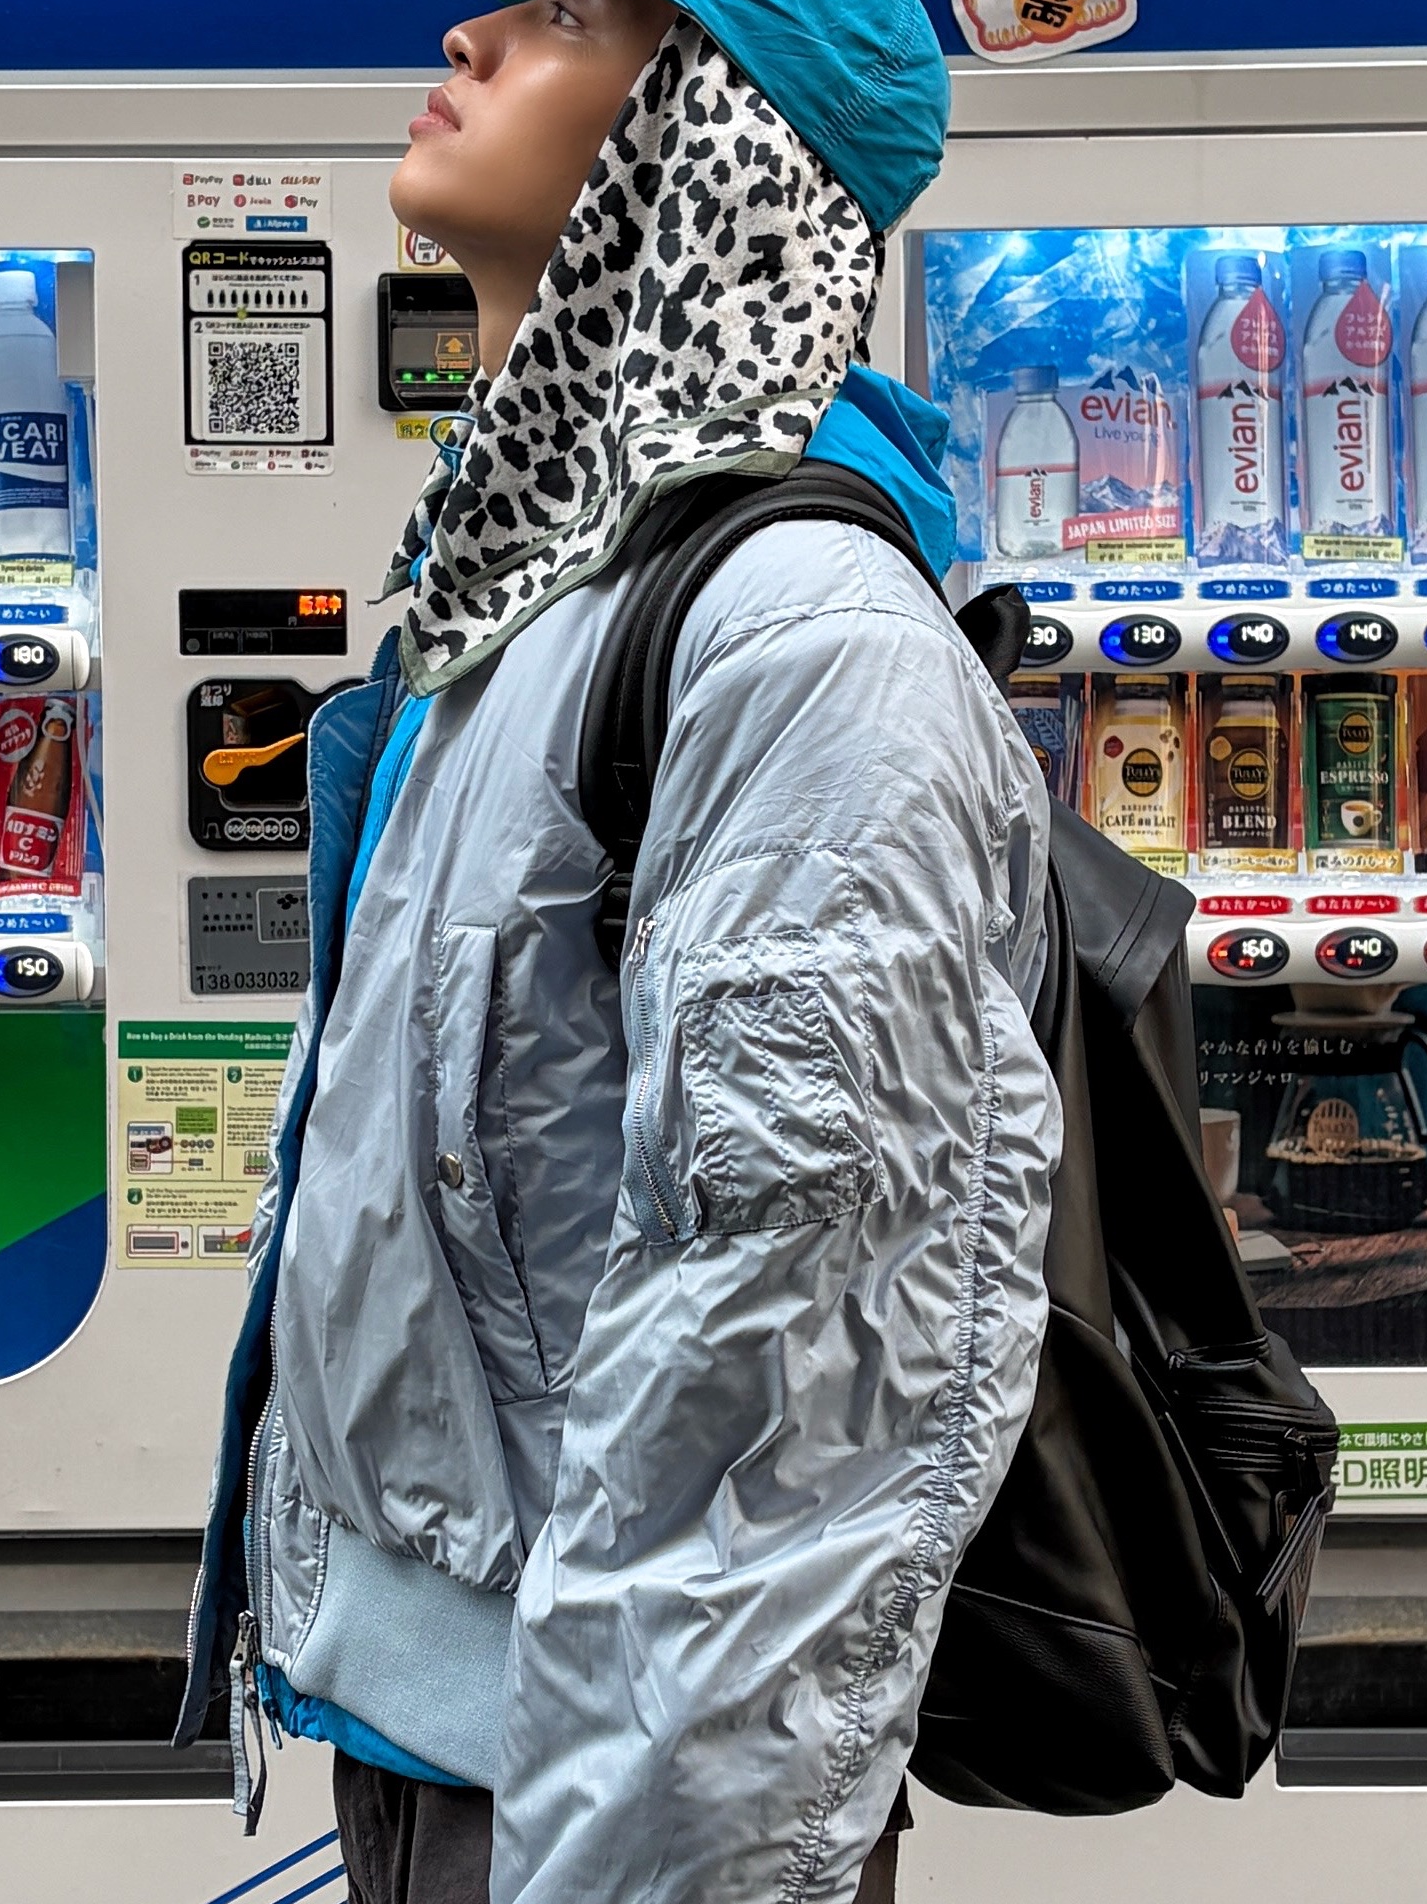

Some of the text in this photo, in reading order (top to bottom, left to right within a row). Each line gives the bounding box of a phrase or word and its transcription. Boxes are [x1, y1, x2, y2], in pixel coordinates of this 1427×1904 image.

[197, 194, 220, 207] Pay
[300, 197, 319, 208] Pay
[194, 321, 203, 333] 2
[1228, 400, 1260, 495] evian
[1334, 397, 1366, 493] evian
[1029, 478, 1041, 519] evian
[1068, 519, 1107, 539] JAPAN
[1109, 516, 1152, 535] LIMITED
[1133, 625, 1165, 644] 130
[1241, 624, 1273, 642] 140
[1349, 623, 1382, 641] 140
[13, 646, 45, 663] 180
[201, 684, 233, 697] おつり
[1320, 771, 1389, 785] ESPRESSO
[1105, 810, 1135, 829] CAFÉ
[1153, 814, 1177, 829] LAIT
[1222, 815, 1277, 830] BLEND
[4, 818, 58, 843] オロナミン
[18, 837, 34, 852] C
[1242, 940, 1274, 958] 160
[1349, 938, 1382, 956] 140
[196, 970, 300, 992] 138 033032
